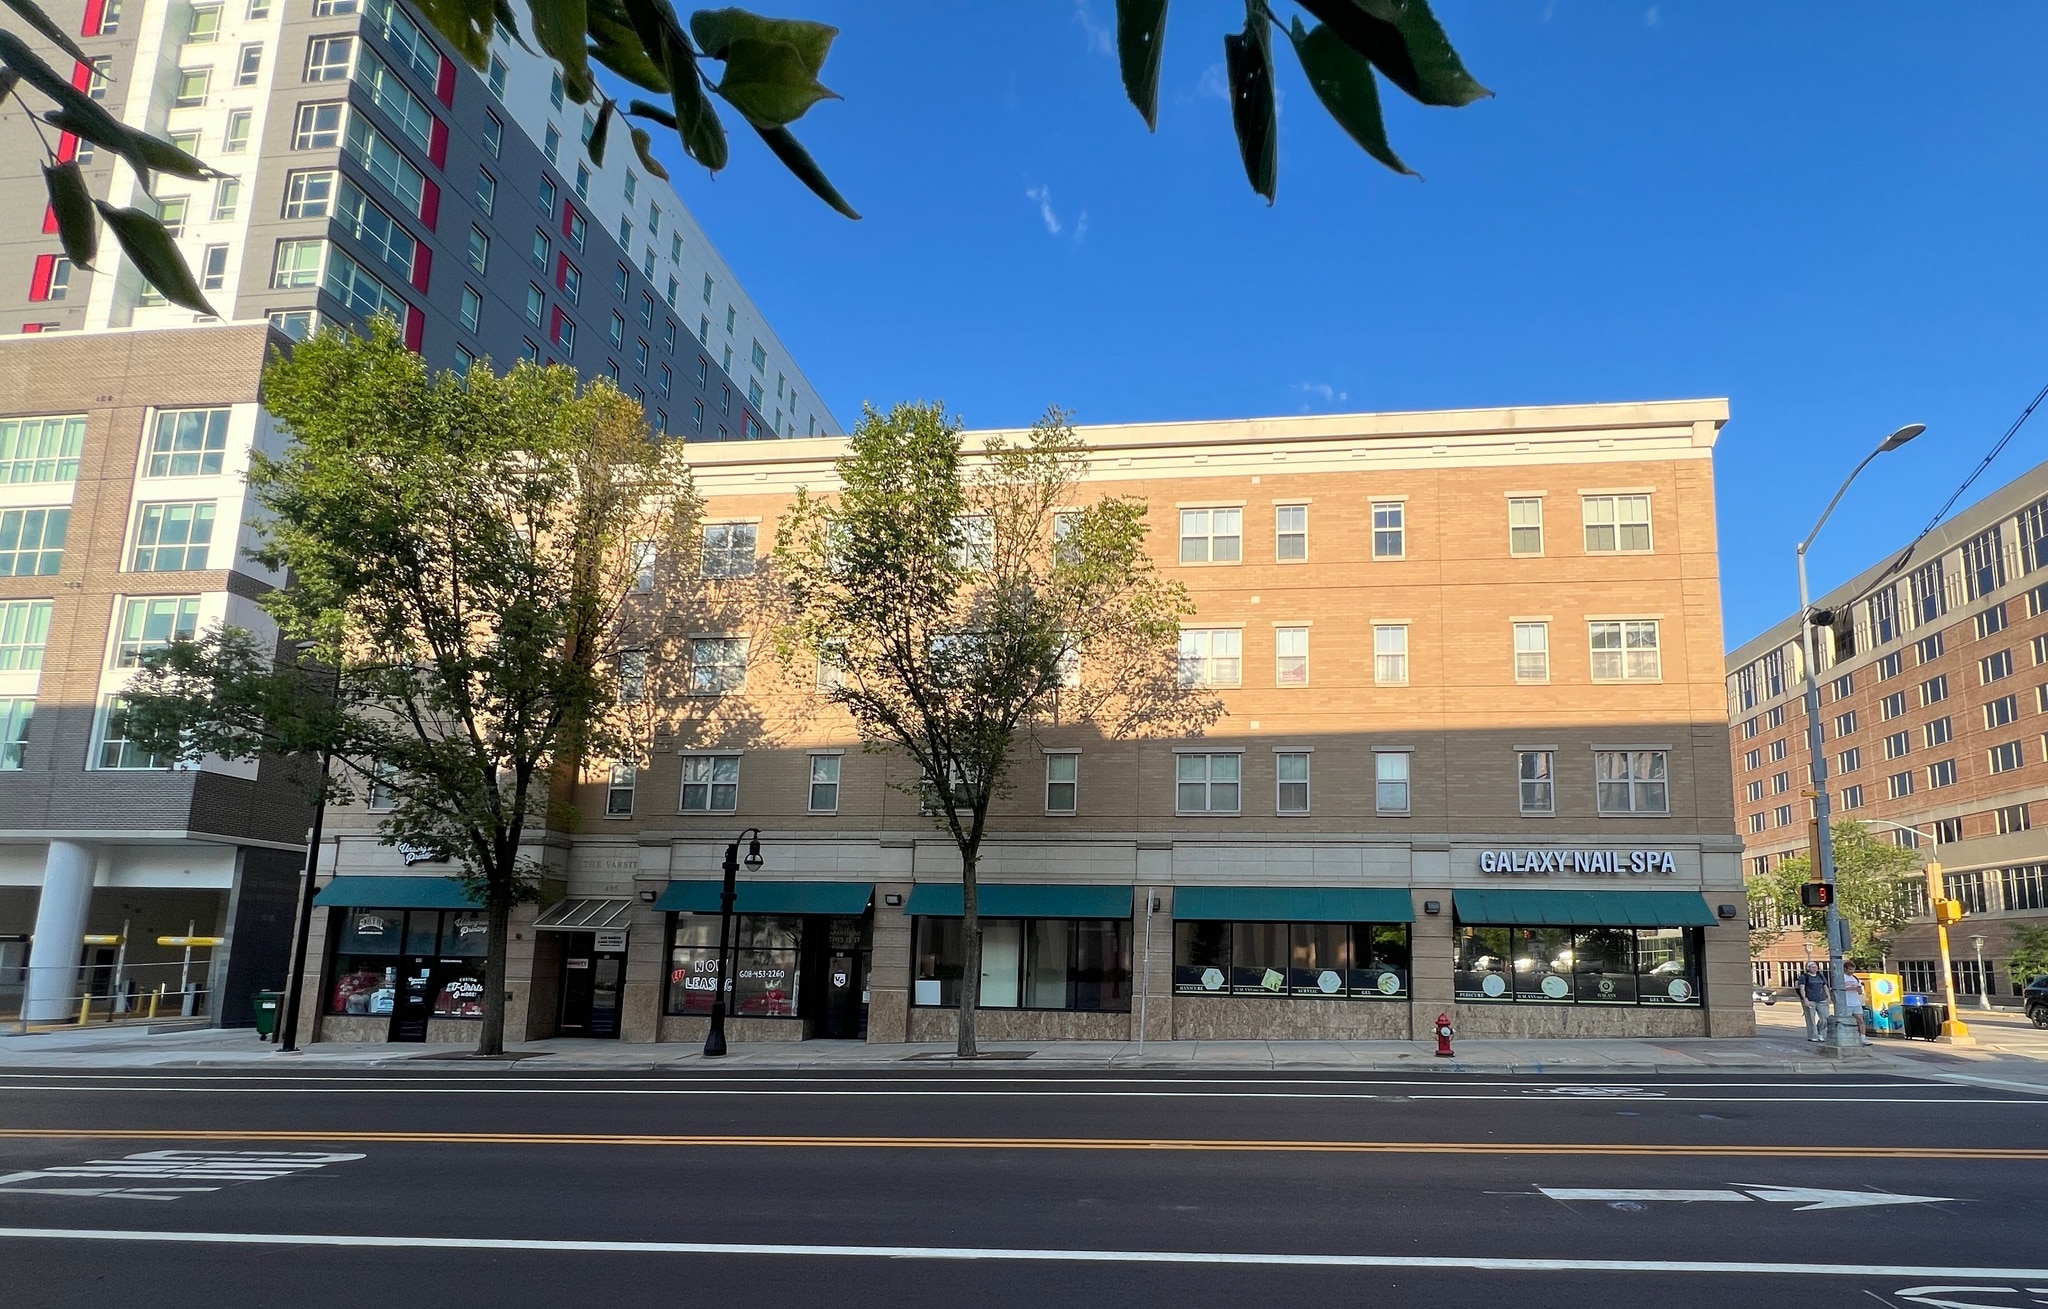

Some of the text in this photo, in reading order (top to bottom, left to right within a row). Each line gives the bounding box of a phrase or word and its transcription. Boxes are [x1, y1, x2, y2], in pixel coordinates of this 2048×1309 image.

[606, 861, 638, 869] VARSIT
[1480, 850, 1677, 873] GALAXY NAIL SPA
[685, 977, 732, 992] LEASG
